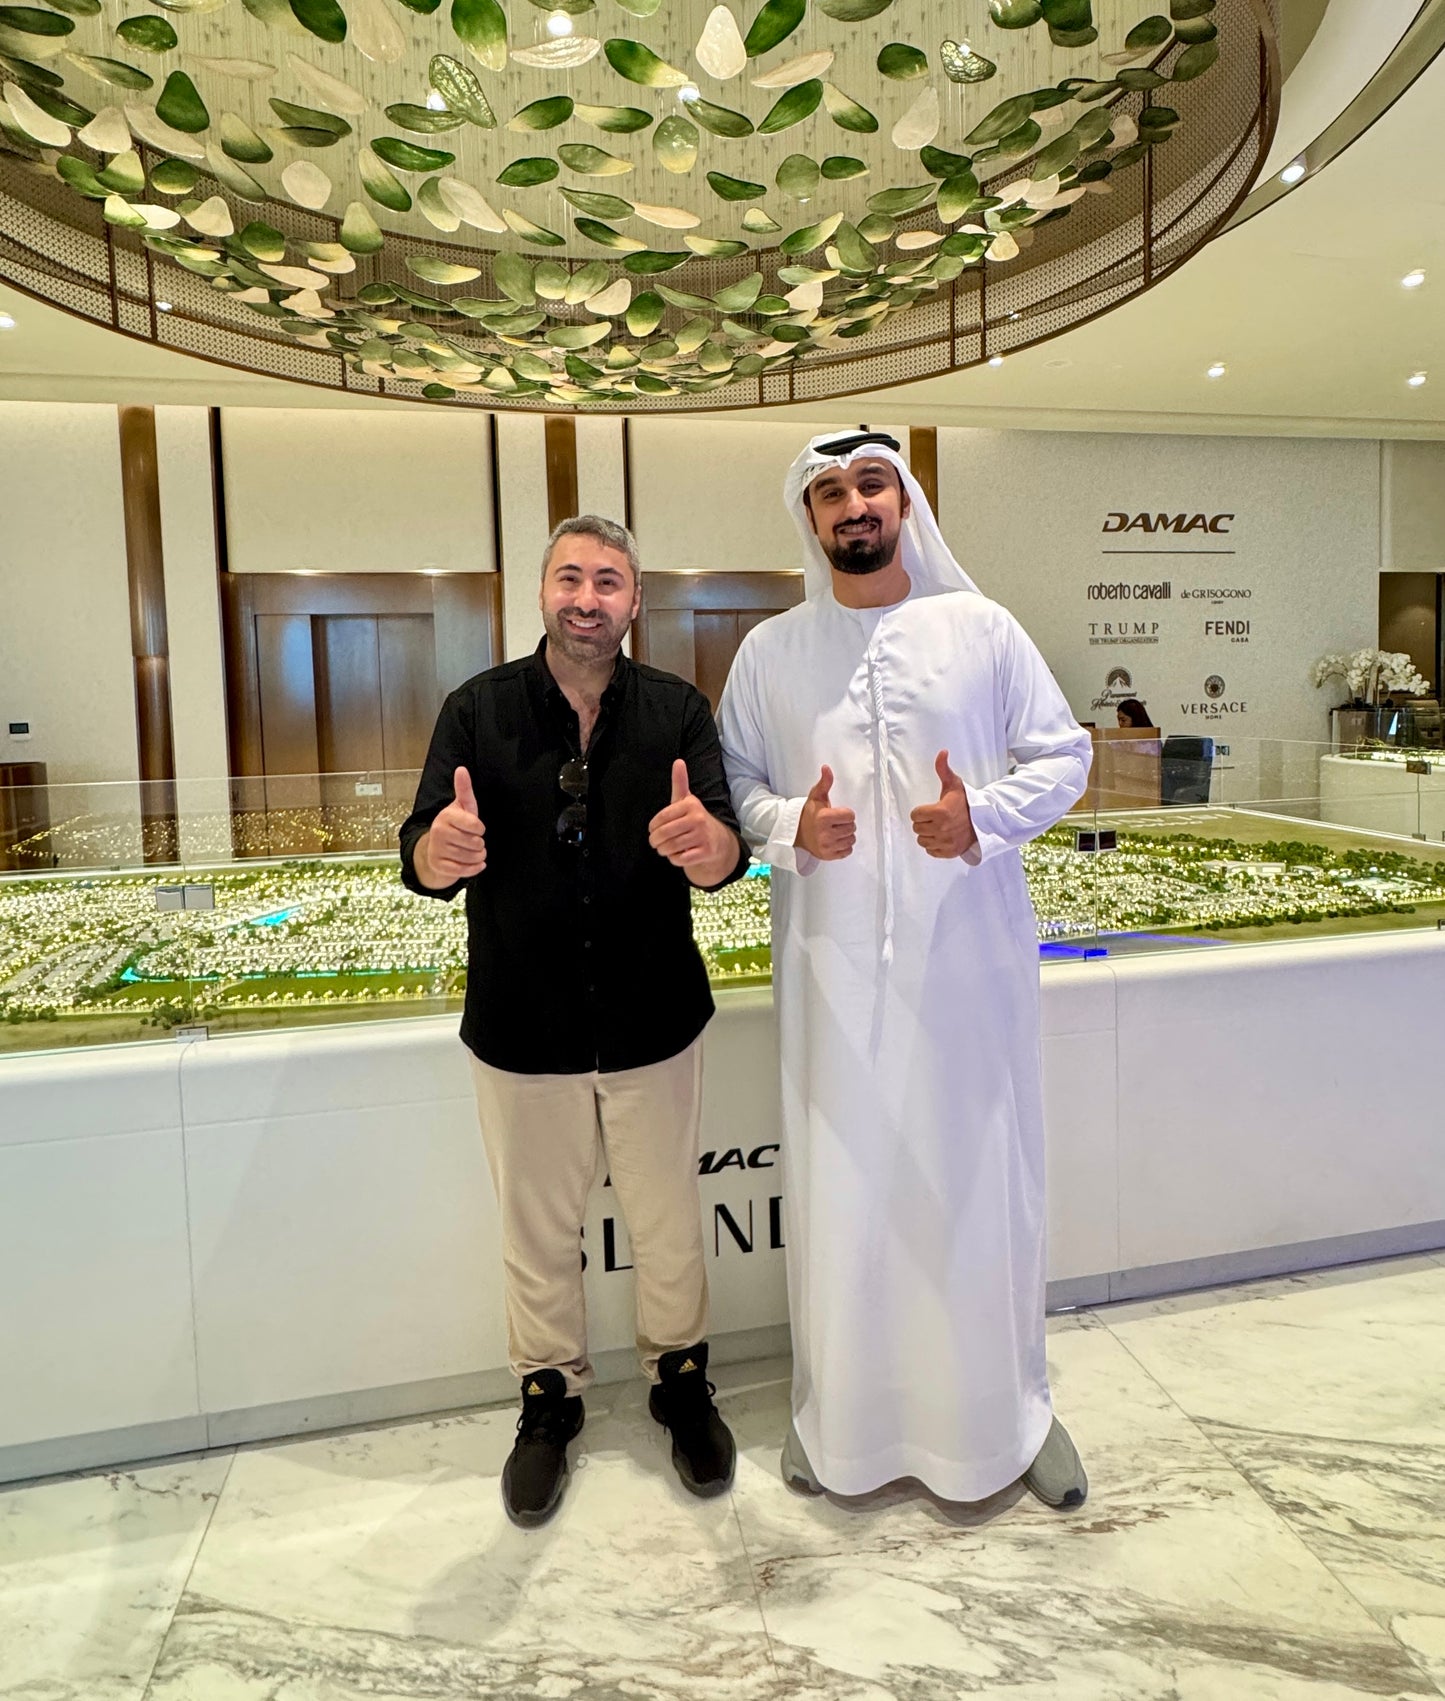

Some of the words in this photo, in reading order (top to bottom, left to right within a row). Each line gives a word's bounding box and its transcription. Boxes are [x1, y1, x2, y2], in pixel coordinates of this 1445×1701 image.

[1102, 513, 1235, 533] DAMAC
[1088, 582, 1130, 600] roberto
[1133, 581, 1171, 600] cavalli
[1181, 589, 1191, 599] de
[1192, 588, 1252, 599] GRISOGONO
[1089, 622, 1159, 635] TRUMP
[1205, 620, 1250, 635] FENDI
[1181, 701, 1248, 714] VERSACE
